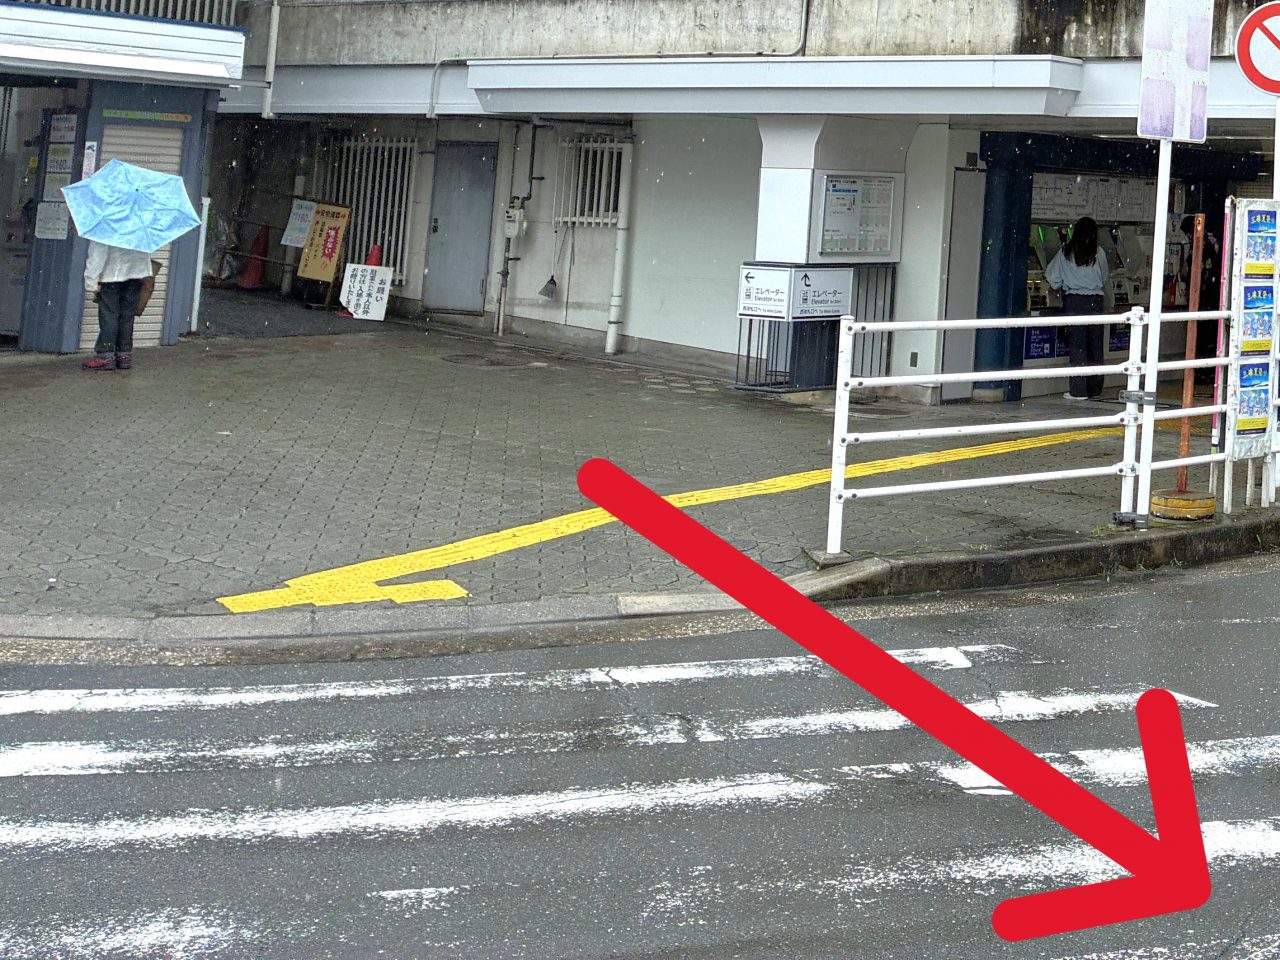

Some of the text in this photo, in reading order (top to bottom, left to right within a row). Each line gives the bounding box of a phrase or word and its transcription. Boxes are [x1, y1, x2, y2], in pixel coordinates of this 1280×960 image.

[755, 287, 785, 296] エレベーター
[812, 289, 843, 298] エレベーター
